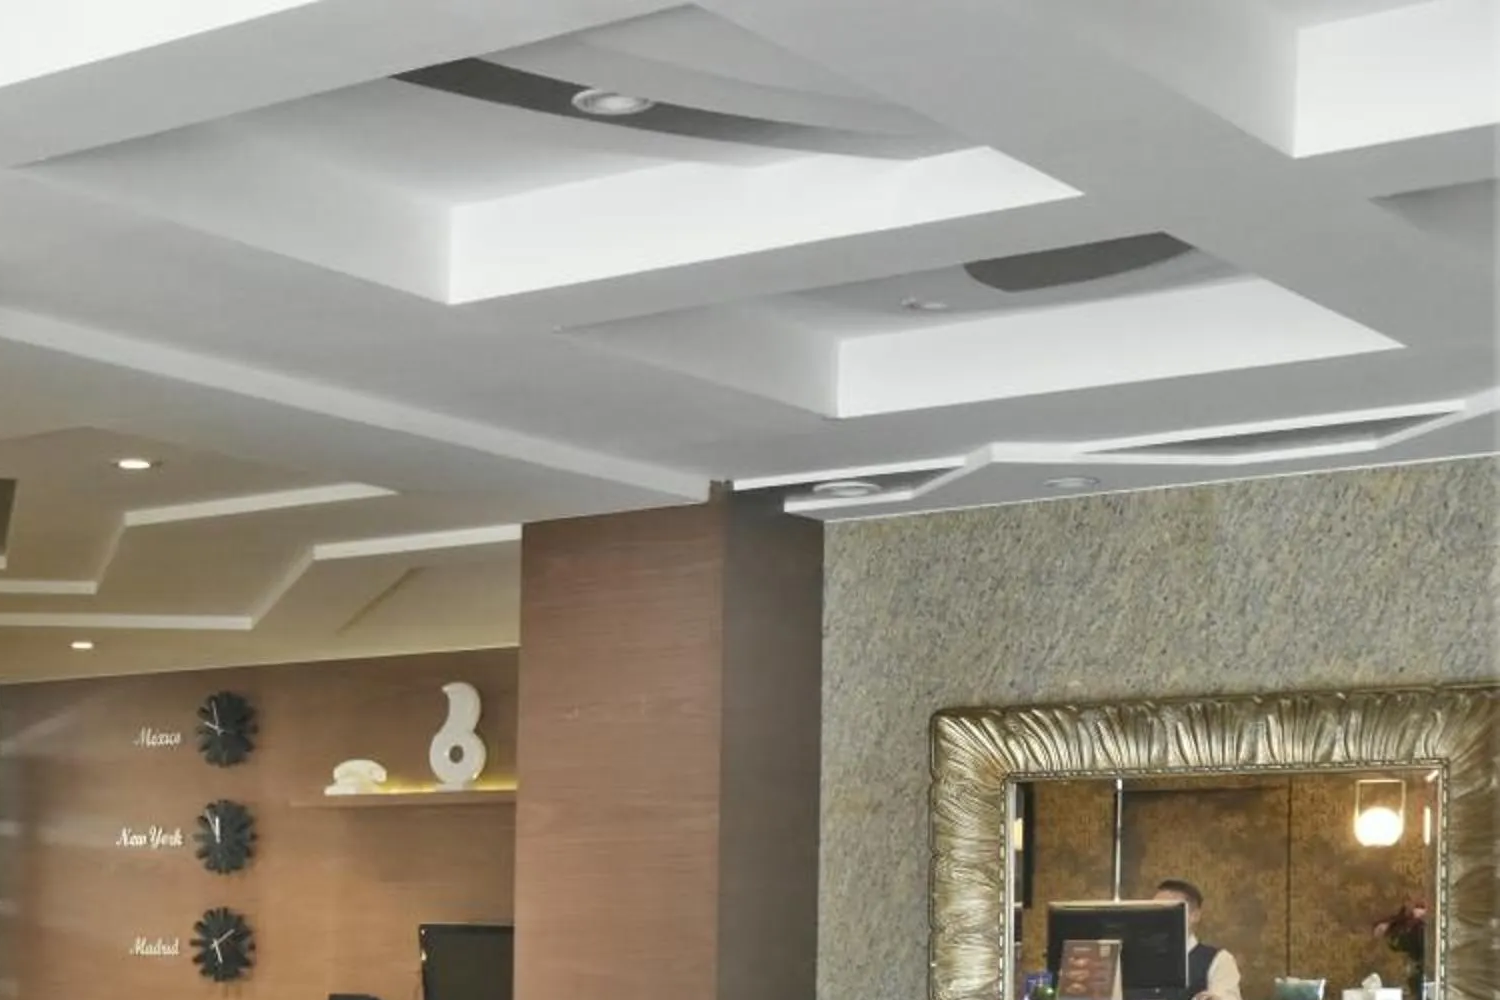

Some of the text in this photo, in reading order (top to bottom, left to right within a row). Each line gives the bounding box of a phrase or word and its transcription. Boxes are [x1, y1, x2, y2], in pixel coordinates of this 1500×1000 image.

[116, 824, 185, 850] New York
[129, 936, 180, 956] Madrid
